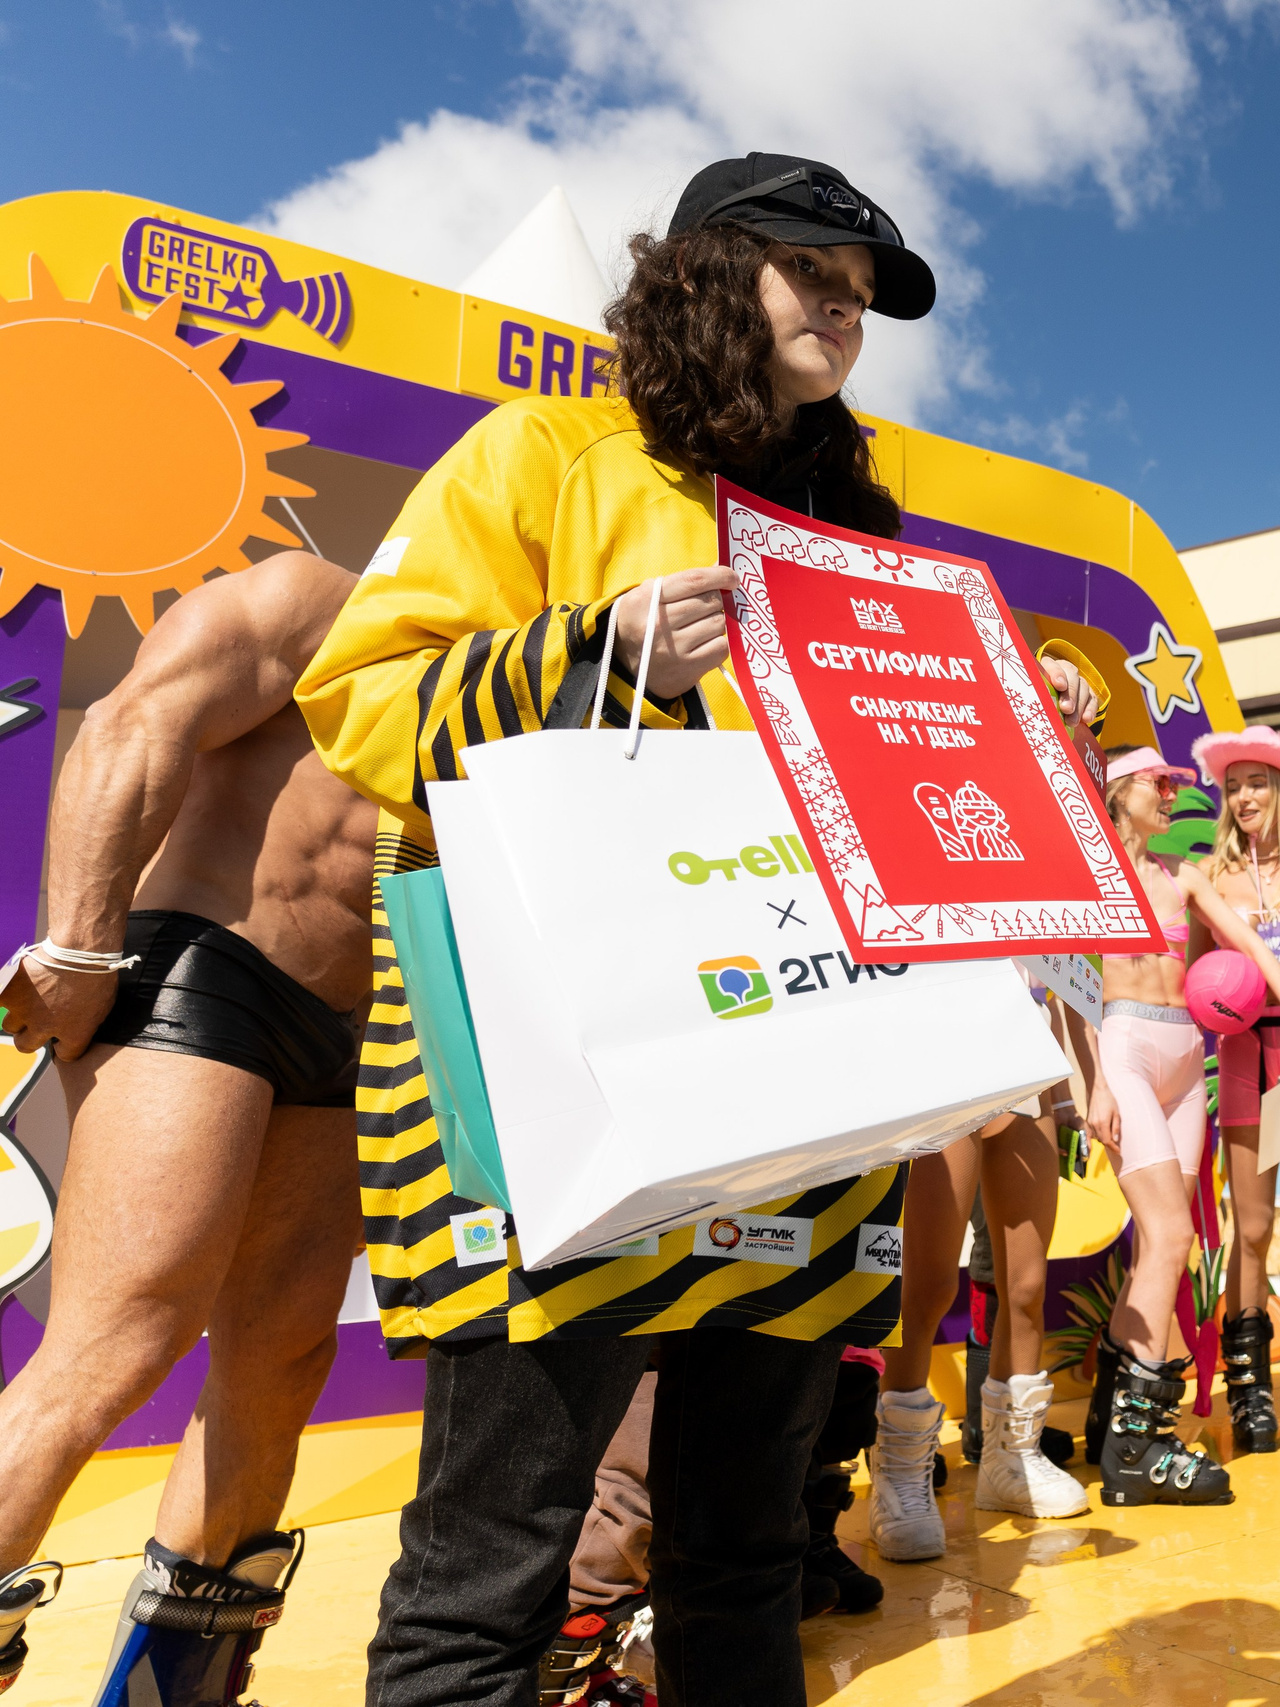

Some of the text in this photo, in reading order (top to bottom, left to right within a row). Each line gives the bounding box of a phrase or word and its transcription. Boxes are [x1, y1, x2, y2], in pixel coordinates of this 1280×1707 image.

[148, 230, 258, 283] GRELKA
[145, 262, 221, 304] FEST
[498, 320, 628, 398] GRE
[850, 597, 898, 617] MAX
[854, 610, 903, 629] BUS
[807, 641, 977, 682] СЕРТИФИКАТ
[850, 695, 982, 725] СНАРЯЖЕНИЕ
[876, 722, 976, 749] НА 1 ДЕНЬ
[1085, 742, 1104, 789] 2024
[744, 1242, 795, 1252] ЗАСТРОЙЩИК
[747, 1226, 795, 1241] УГМК
